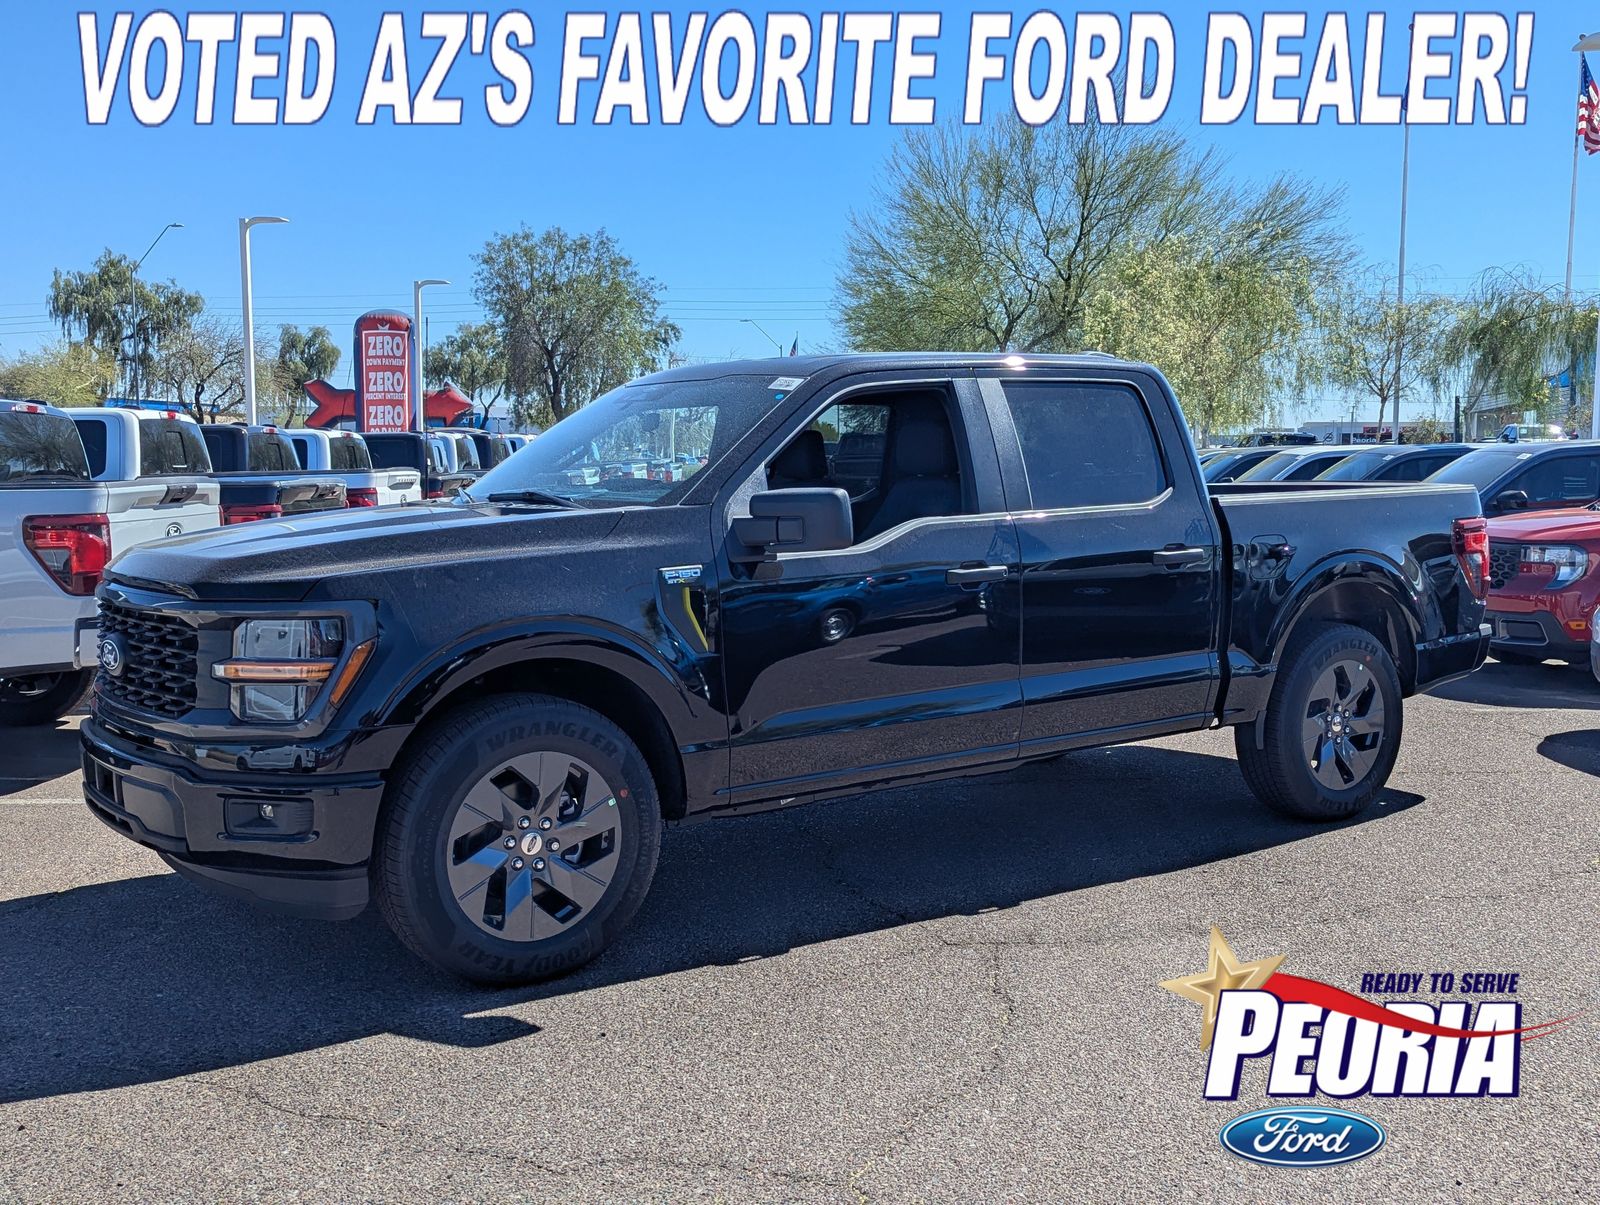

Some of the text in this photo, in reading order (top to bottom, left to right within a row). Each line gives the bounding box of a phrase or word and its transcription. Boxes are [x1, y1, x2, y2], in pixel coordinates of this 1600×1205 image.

[367, 336, 404, 356] ZERO
[366, 358, 405, 366] DOWN PAYMENT
[368, 371, 404, 392] ZERO
[368, 405, 404, 426] ZERO
[662, 569, 700, 580] F-150
[485, 719, 619, 759] WRANGLER
